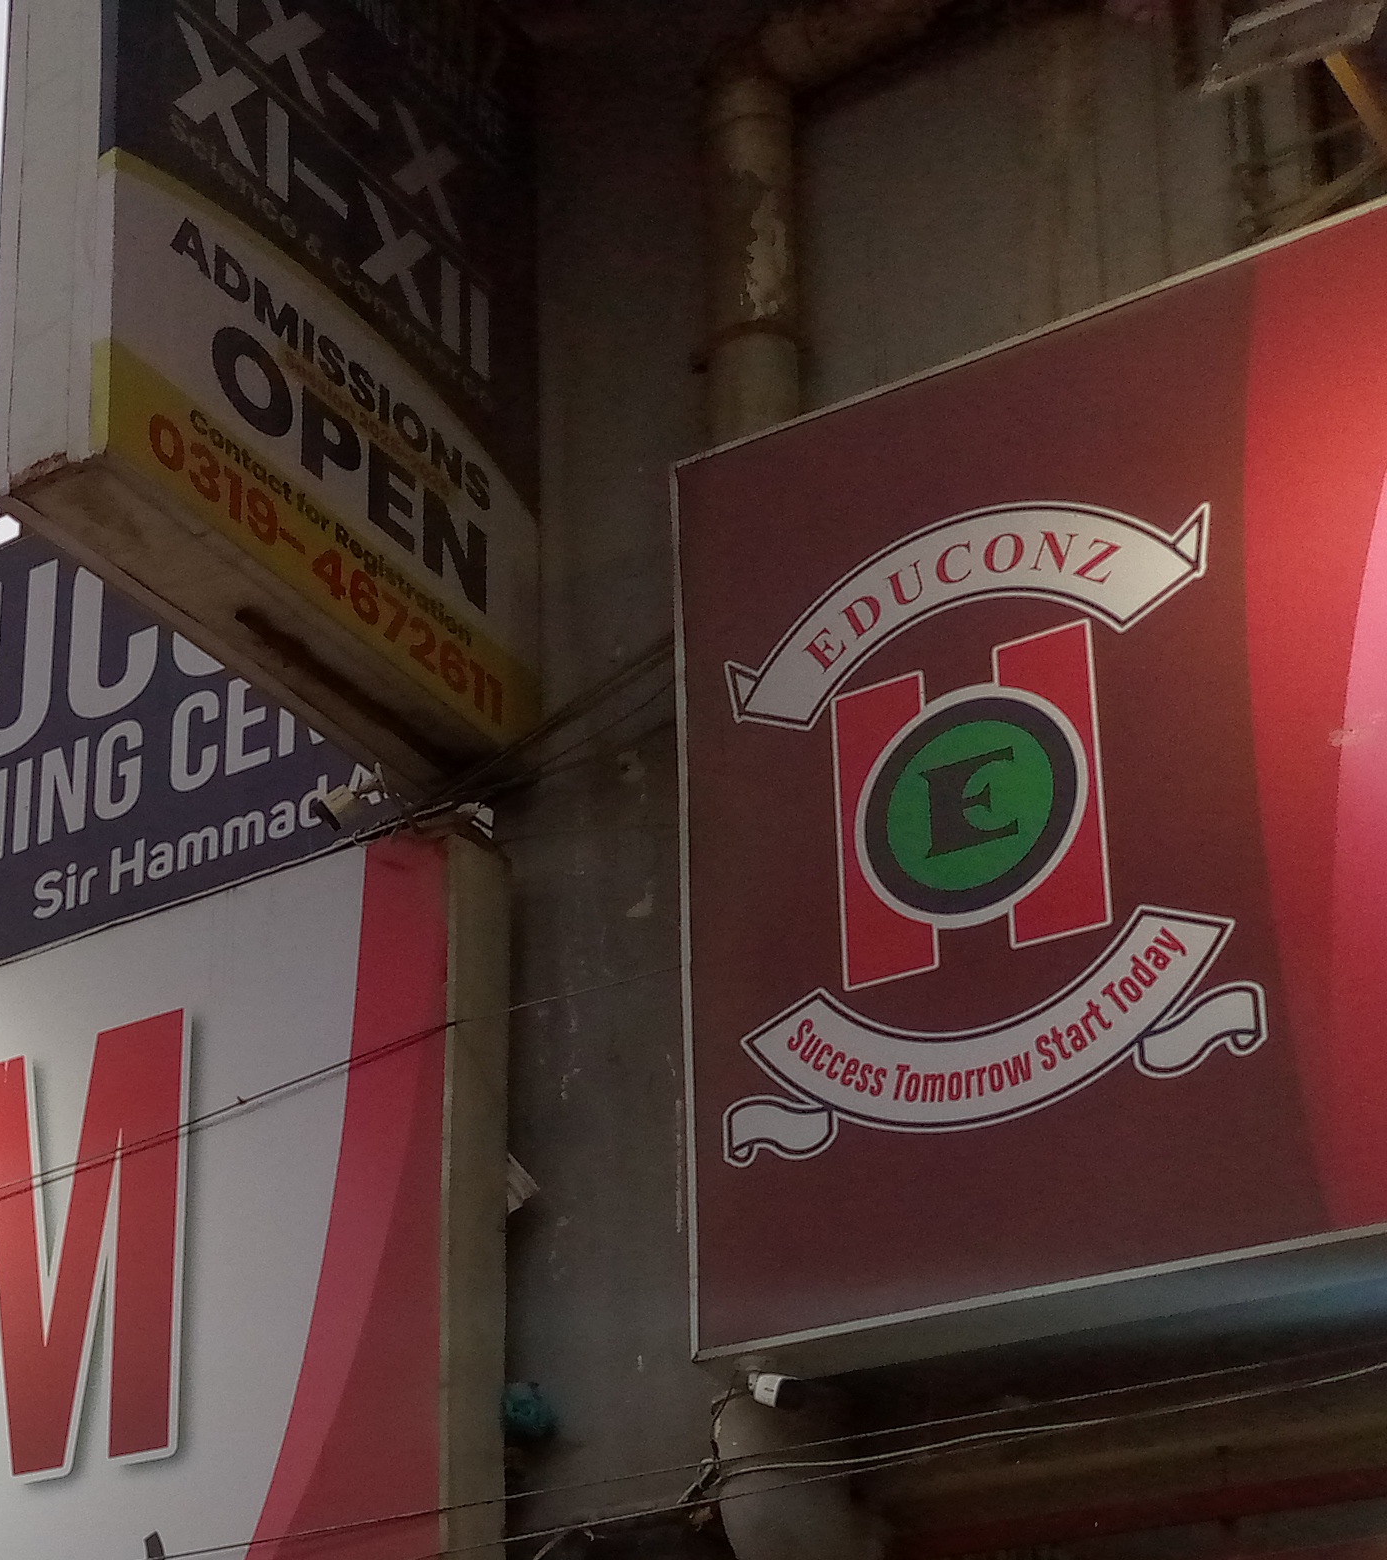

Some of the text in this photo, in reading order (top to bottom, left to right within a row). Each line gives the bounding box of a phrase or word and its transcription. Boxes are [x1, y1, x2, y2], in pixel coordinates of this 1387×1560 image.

[172, 13, 490, 381] XI-XII
[170, 218, 490, 511] ADMISSIONS
[211, 325, 487, 615] OPEN
[189, 408, 473, 647] Contact for Registration
[802, 529, 1125, 675] EDUCONZ
[33, 861, 98, 922] Sir
[109, 773, 328, 898] Hammad
[787, 926, 1189, 1103] Success Tomorrow Start Today
